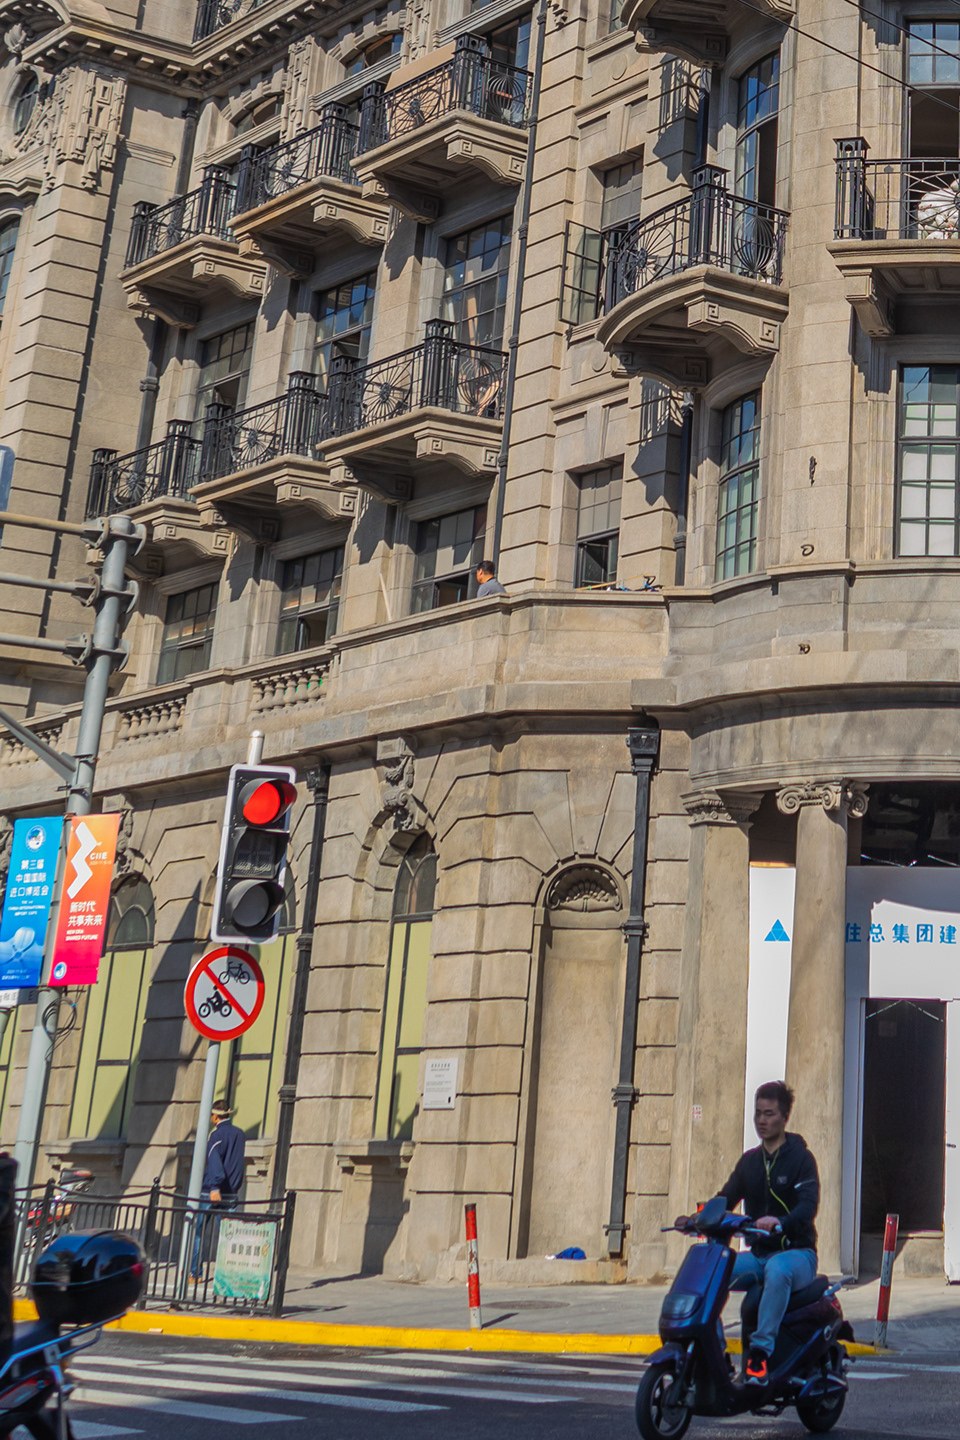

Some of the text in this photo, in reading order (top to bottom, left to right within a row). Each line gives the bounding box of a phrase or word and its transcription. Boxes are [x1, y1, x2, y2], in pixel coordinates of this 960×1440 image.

[89, 851, 108, 860] CIIE
[21, 859, 44, 870] 第三届
[15, 872, 47, 884] 中国国际
[9, 885, 49, 898] 进口博览会
[70, 901, 96, 913] 新时代
[67, 914, 103, 927] 共享未来
